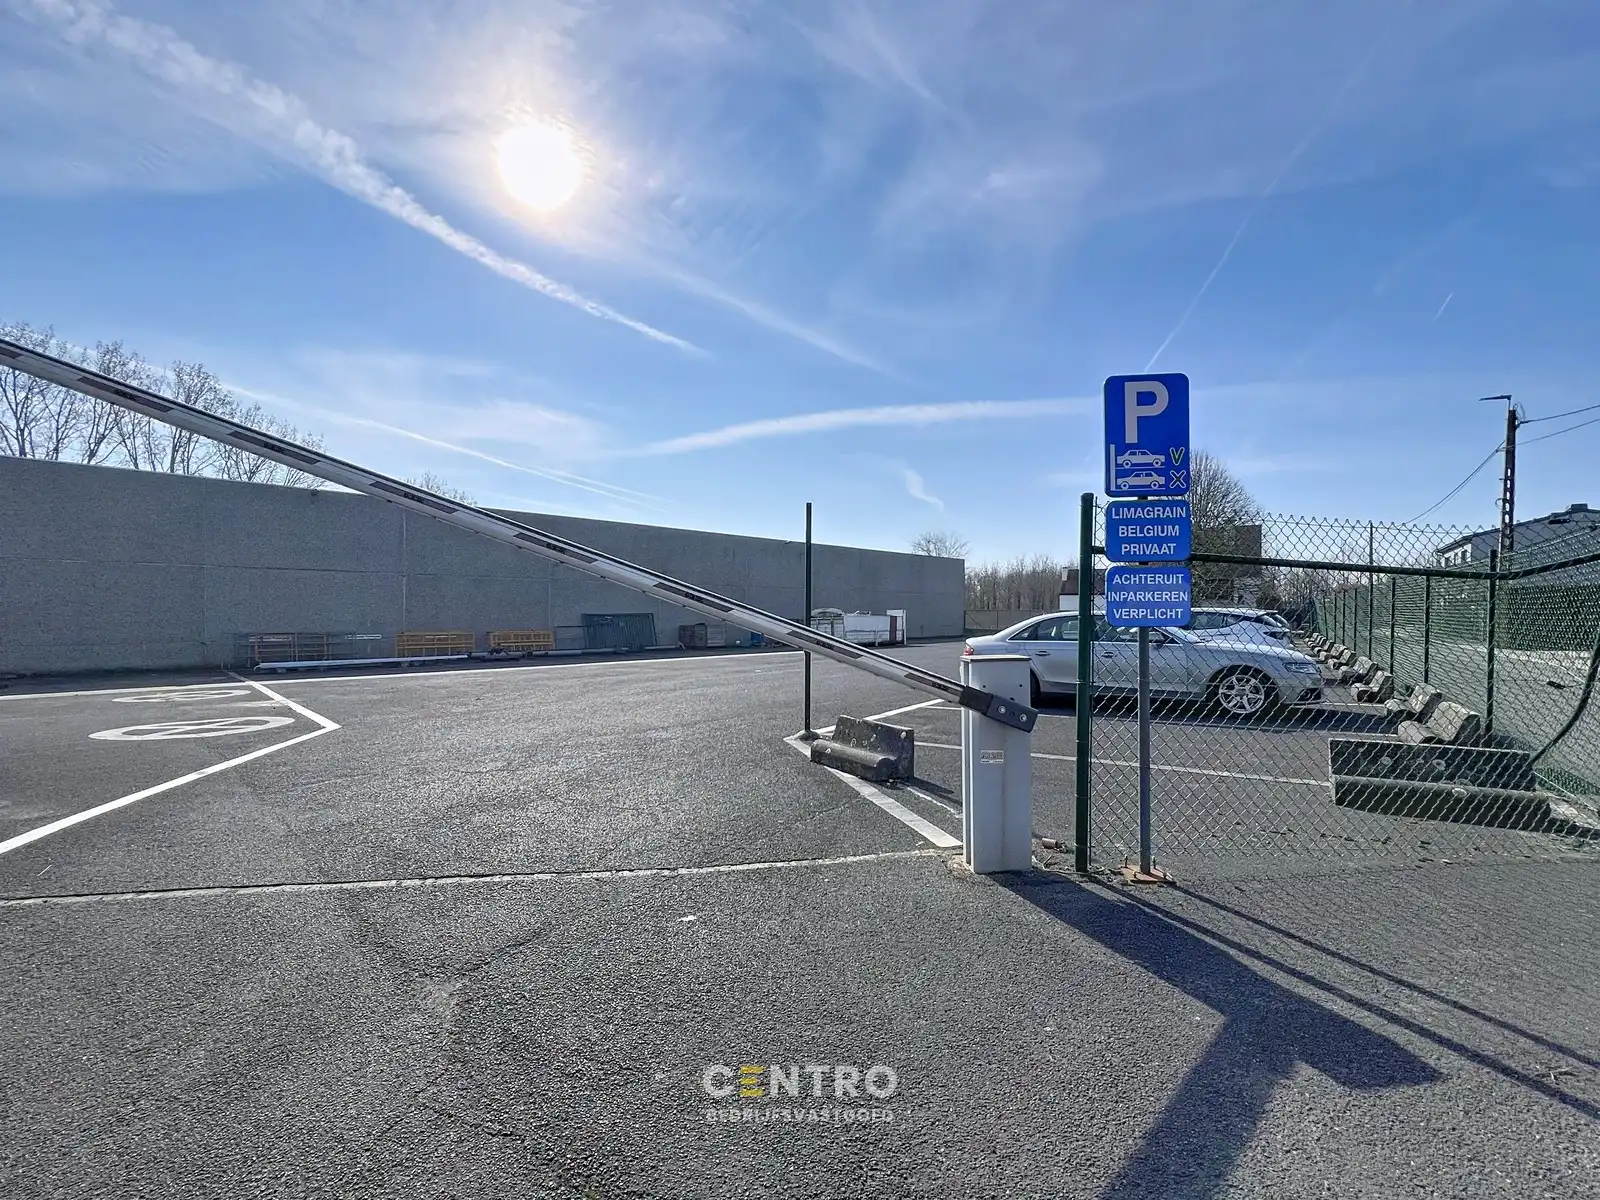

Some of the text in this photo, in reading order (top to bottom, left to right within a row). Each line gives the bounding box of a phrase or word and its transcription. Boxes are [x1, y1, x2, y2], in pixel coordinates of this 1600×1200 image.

[1124, 380, 1169, 444] P
[1112, 506, 1186, 519] LIMAGRAIN
[1118, 525, 1180, 537] BELGIUM
[1121, 543, 1176, 555] PRIVAAT
[1112, 573, 1184, 585] ACHTERUIT
[1108, 591, 1188, 602] INPARKEREN
[1113, 608, 1184, 619] VERPLICHT
